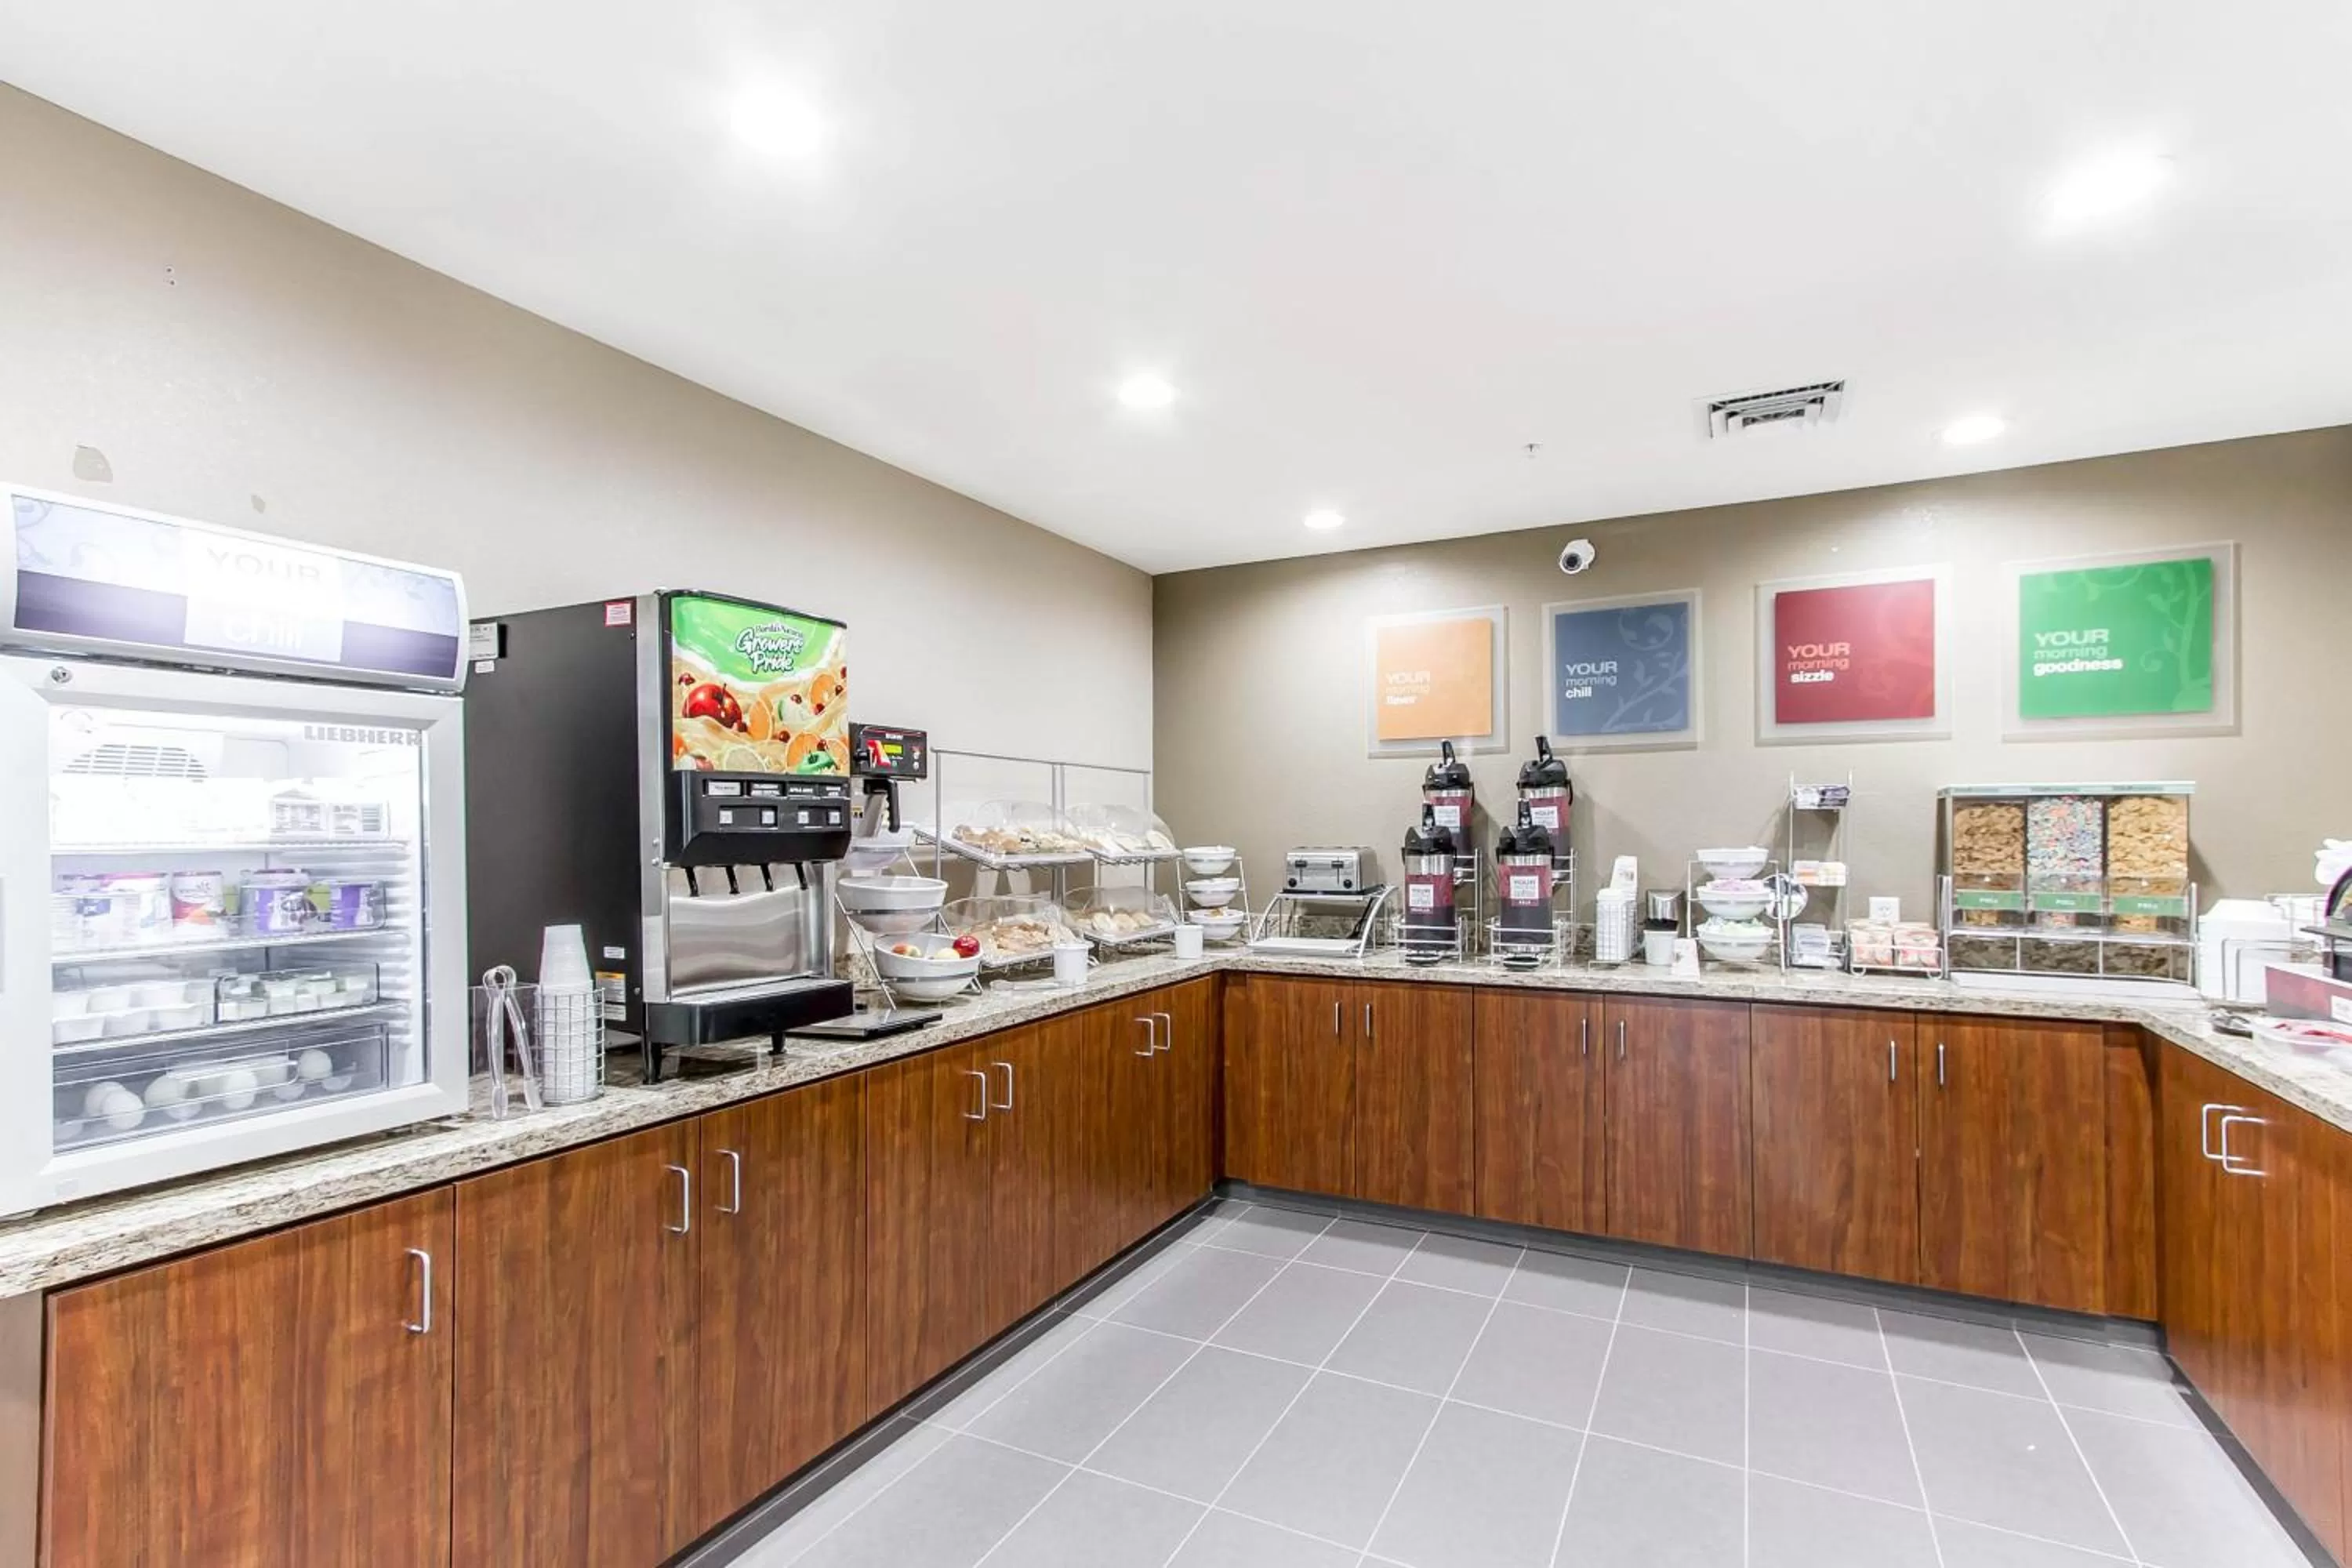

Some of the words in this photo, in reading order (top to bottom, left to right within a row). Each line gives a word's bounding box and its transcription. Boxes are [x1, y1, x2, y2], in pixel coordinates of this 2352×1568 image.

[2034, 629, 2109, 647] YOUR
[1788, 642, 1849, 658] YOUR
[2034, 646, 2107, 661] morning
[751, 652, 793, 674] Pride
[1566, 662, 1617, 675] YOUR
[1788, 659, 1849, 671] morning
[2034, 659, 2122, 677] goodness
[1385, 671, 1430, 684] YOUR
[1566, 676, 1617, 687] morning
[1791, 670, 1835, 684] sizzle
[1566, 687, 1592, 699] chill
[303, 725, 422, 746] LIEBHERR
